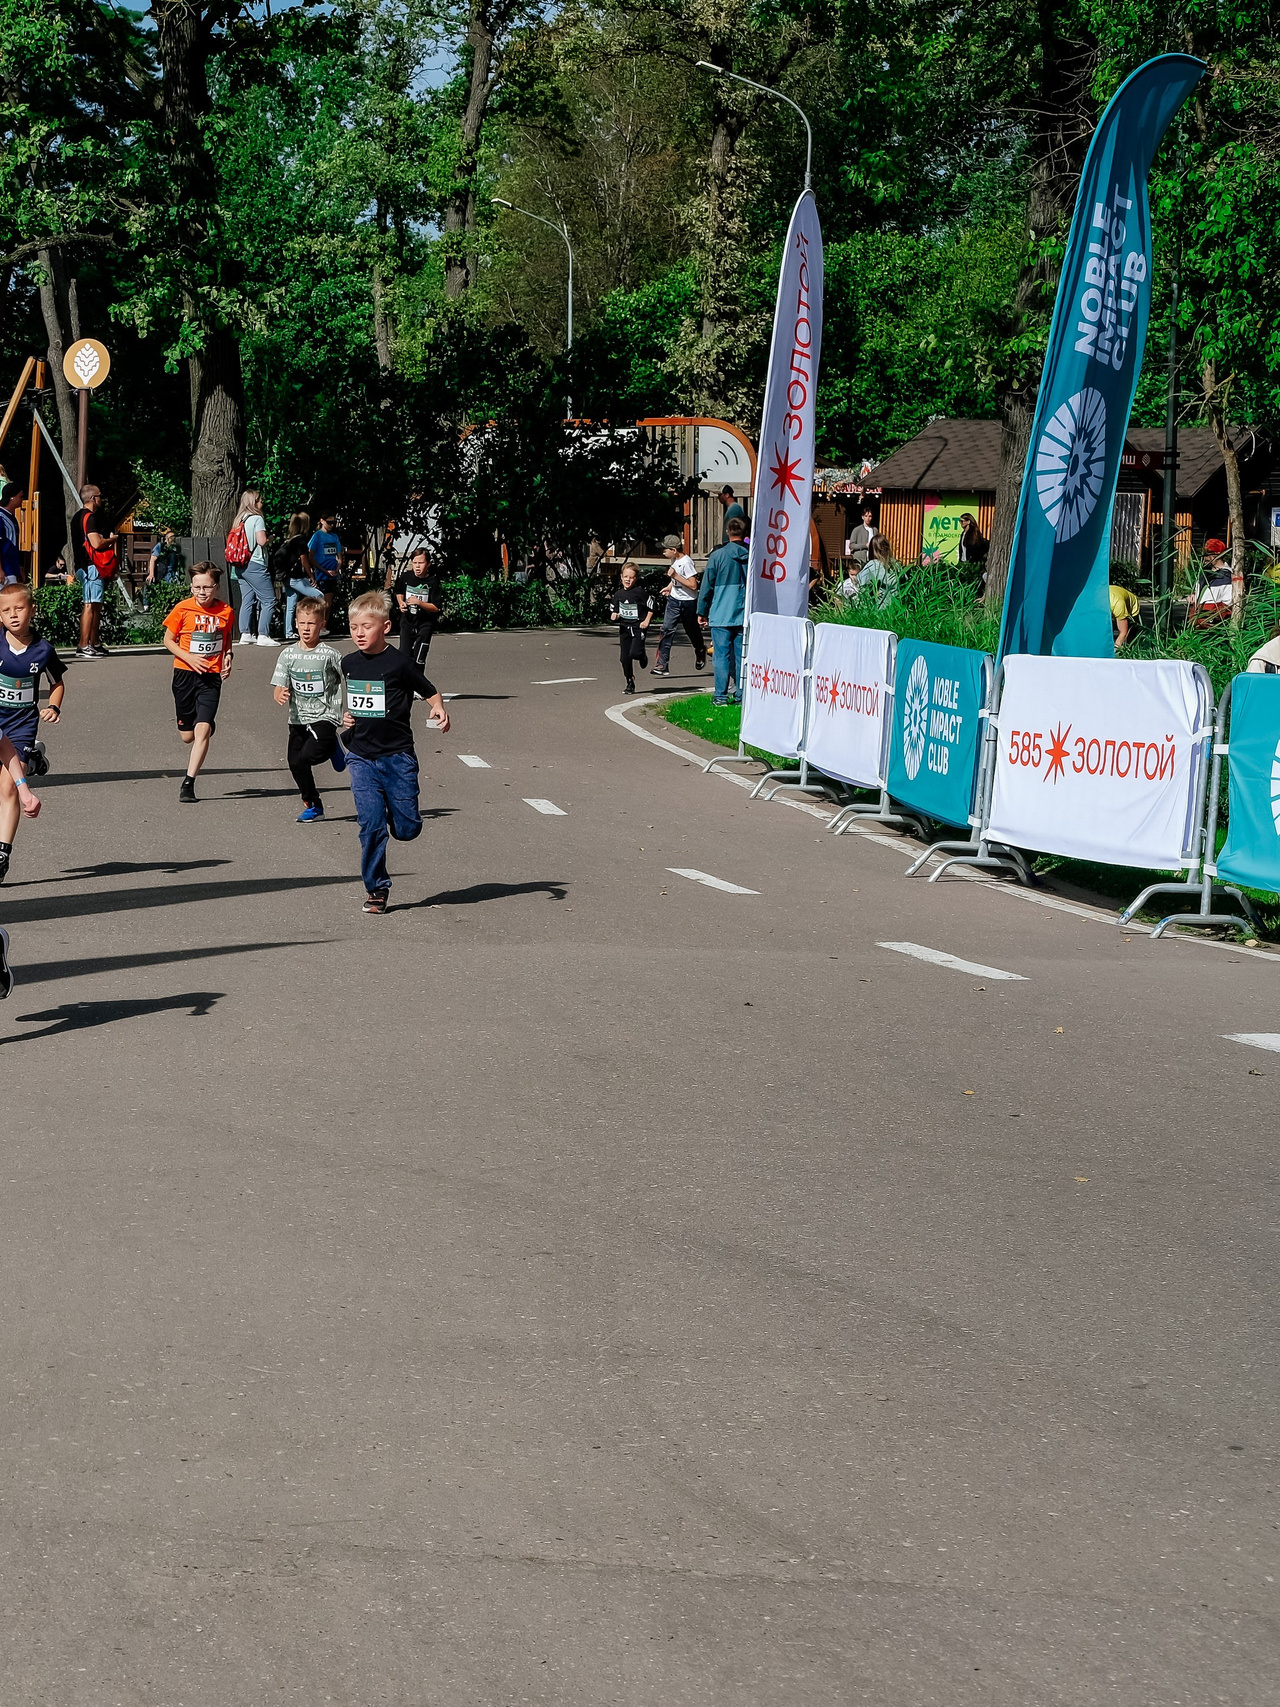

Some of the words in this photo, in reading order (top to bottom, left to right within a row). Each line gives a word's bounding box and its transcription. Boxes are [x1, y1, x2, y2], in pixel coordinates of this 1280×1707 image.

[1074, 202, 1112, 357] NOBLE
[1095, 183, 1133, 366] IMPACT
[1111, 251, 1147, 371] CLUB
[760, 507, 790, 583] 585
[782, 231, 812, 441] ЗОЛОТОЙ
[198, 643, 217, 652] 567
[29, 662, 39, 673] 25
[751, 663, 763, 689] 585
[295, 683, 314, 692] 515
[352, 696, 374, 708] 575
[816, 675, 829, 704] 585
[840, 681, 879, 717] ЗОЛОТОЙ
[932, 676, 960, 710] NOBLE
[929, 709, 962, 745] IMPACT
[927, 742, 949, 776] CLUB
[1009, 730, 1043, 768] 585
[1072, 734, 1176, 781] ЗОЛОТОЙ
